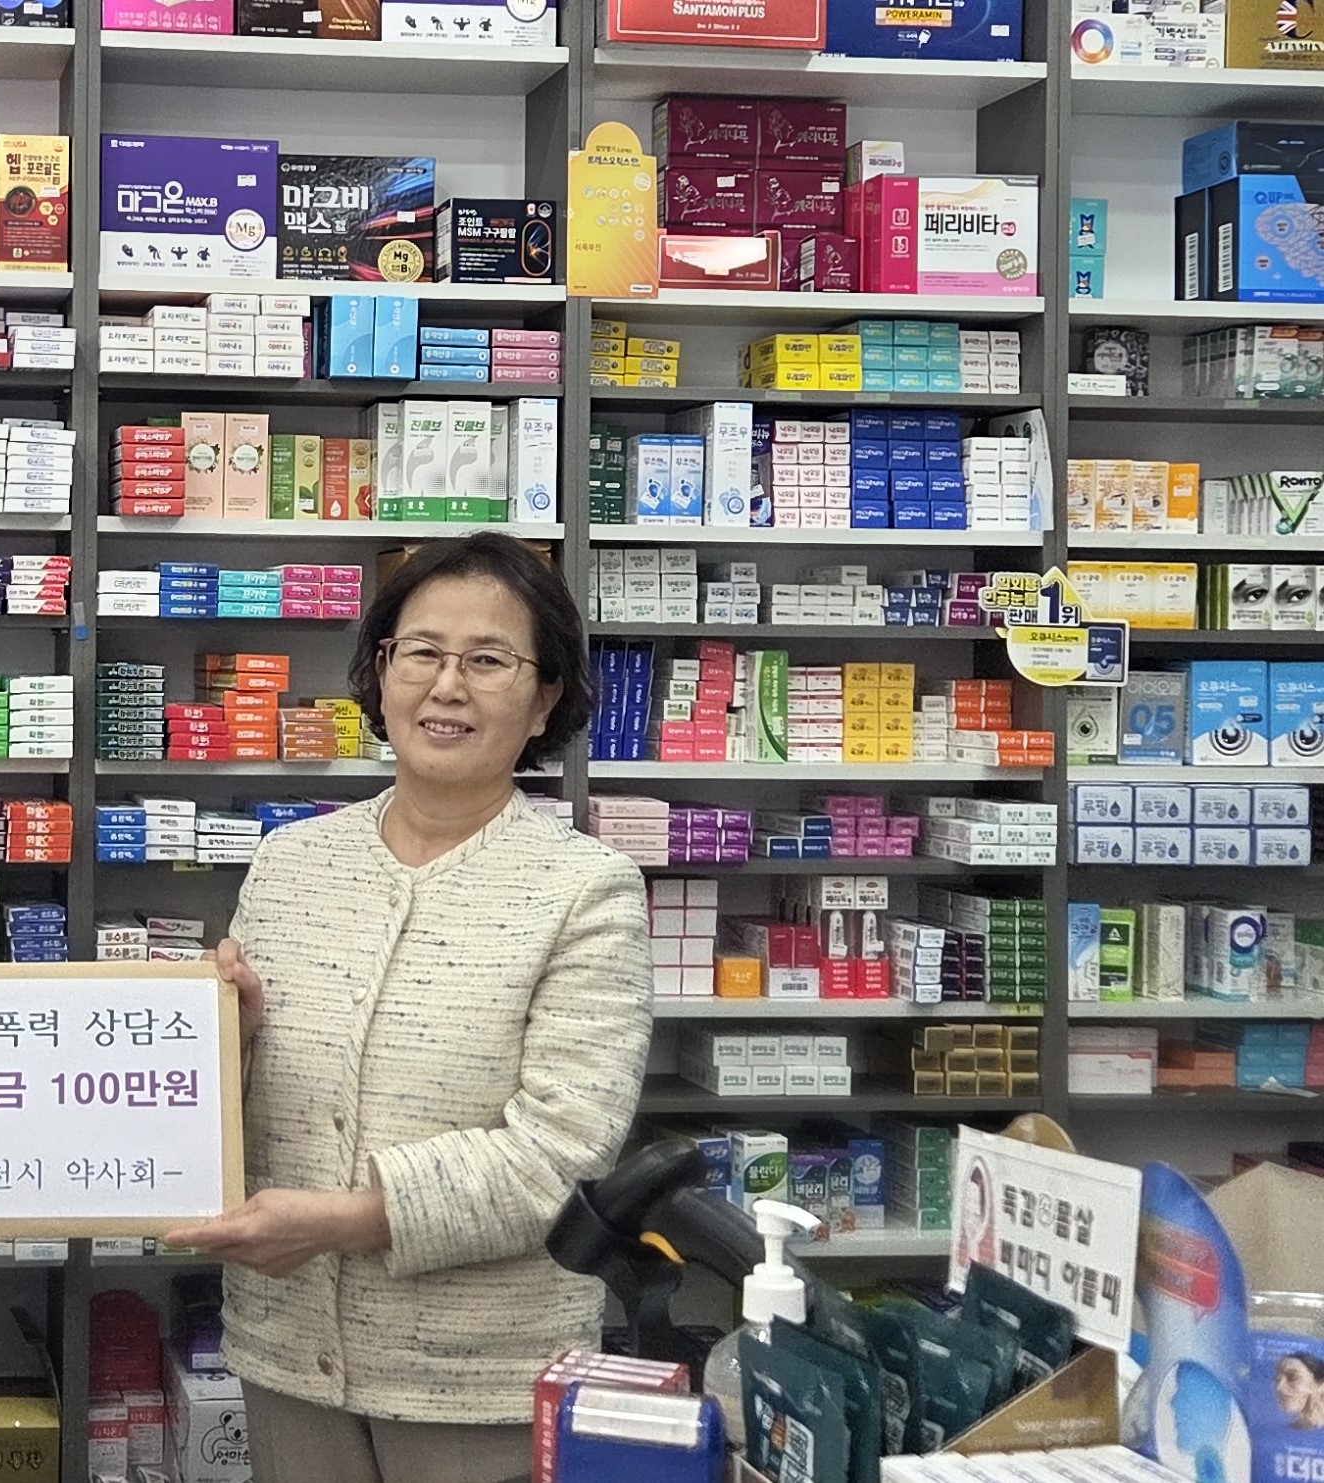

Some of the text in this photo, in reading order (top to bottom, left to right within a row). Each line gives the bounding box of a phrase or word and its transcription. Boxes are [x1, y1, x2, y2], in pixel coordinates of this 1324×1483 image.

[885, 9, 943, 19] POWERAMIN
[117, 181, 184, 214] 마그온
[282, 184, 371, 211] 마그비
[235, 222, 256, 236] Mg
[284, 211, 333, 234] 맥스
[458, 227, 482, 238] MSM
[924, 213, 1000, 236] 페리비타
[393, 251, 408, 263] Mg
[1009, 609, 1038, 623] 판매
[85, 1009, 199, 1048] 상담소
[51, 1069, 200, 1108] 100만원
[1055, 1198, 1094, 1247] 몸살
[1061, 1263, 1122, 1317] 아플때
